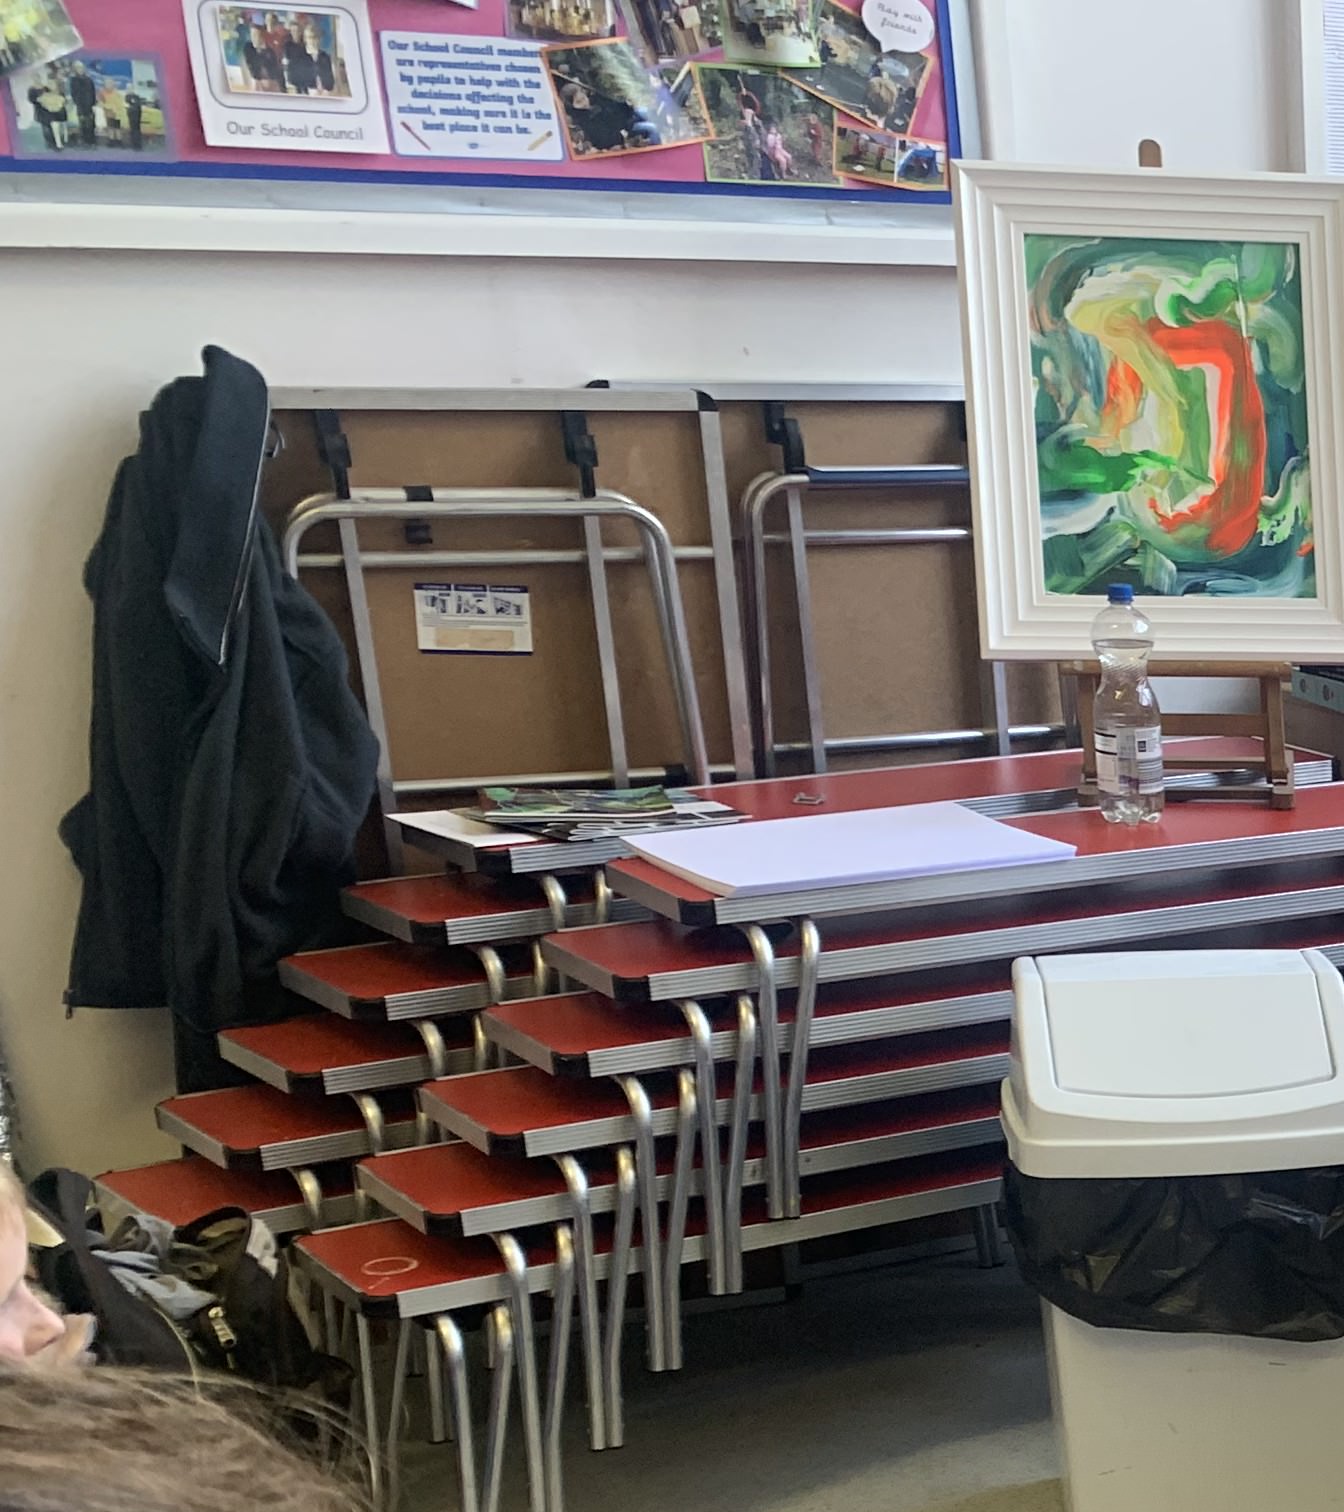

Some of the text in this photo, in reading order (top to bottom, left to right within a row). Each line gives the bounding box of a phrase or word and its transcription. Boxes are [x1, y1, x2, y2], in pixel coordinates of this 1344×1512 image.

[226, 121, 364, 140] Our School Council
